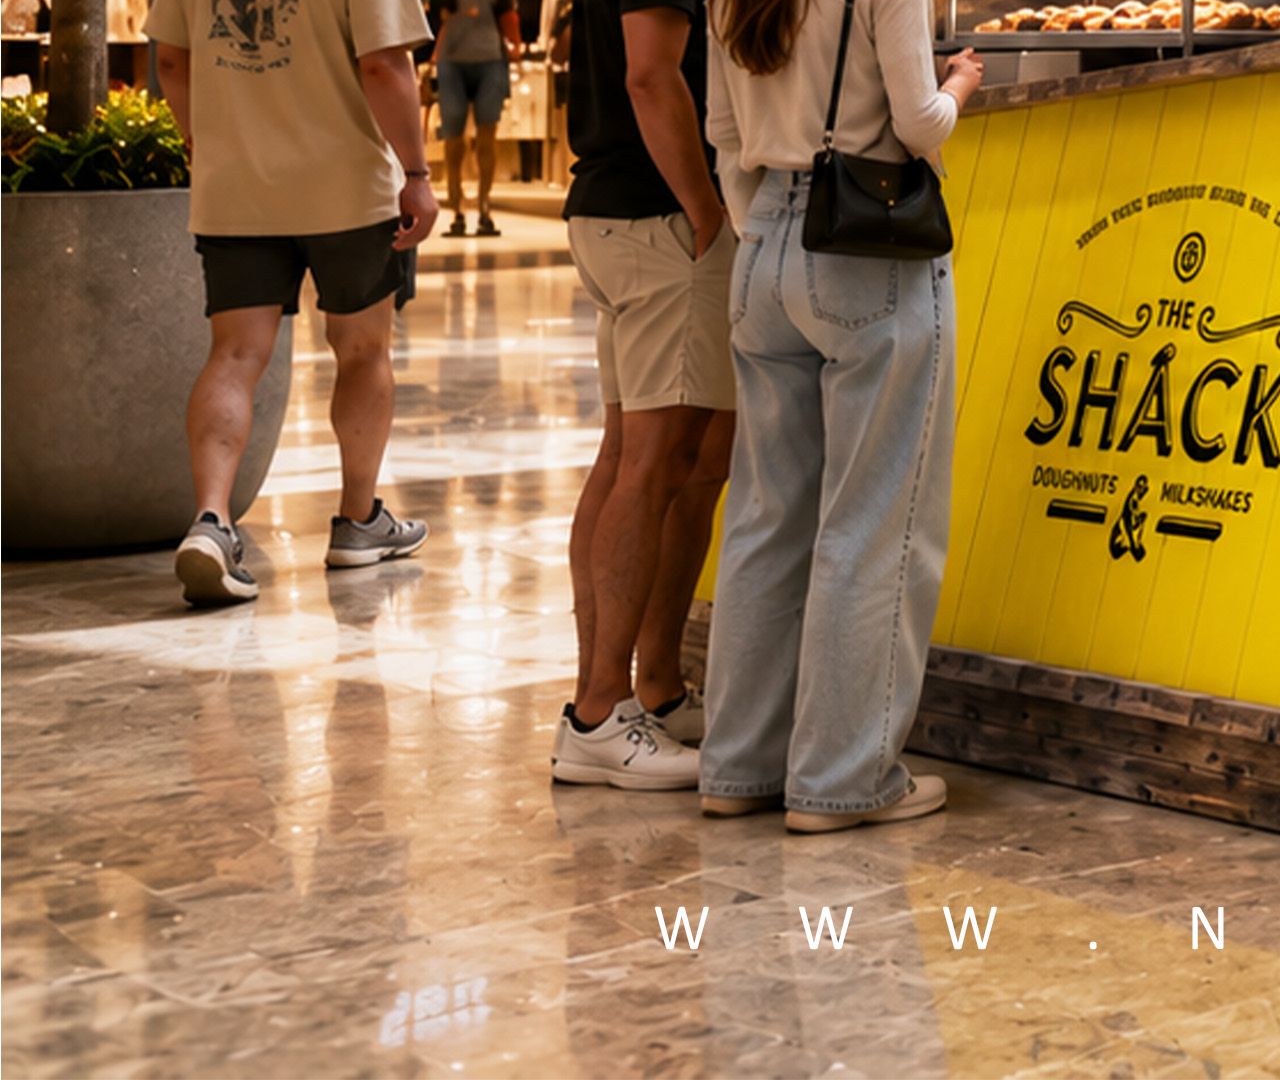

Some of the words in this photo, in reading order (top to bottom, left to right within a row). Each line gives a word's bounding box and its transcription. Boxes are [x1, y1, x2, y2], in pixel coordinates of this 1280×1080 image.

[1157, 299, 1196, 329] THE
[1032, 465, 1118, 495] DOUGHNUTS
[1109, 474, 1149, 562] &
[1160, 482, 1253, 513] MILKSHAKES
